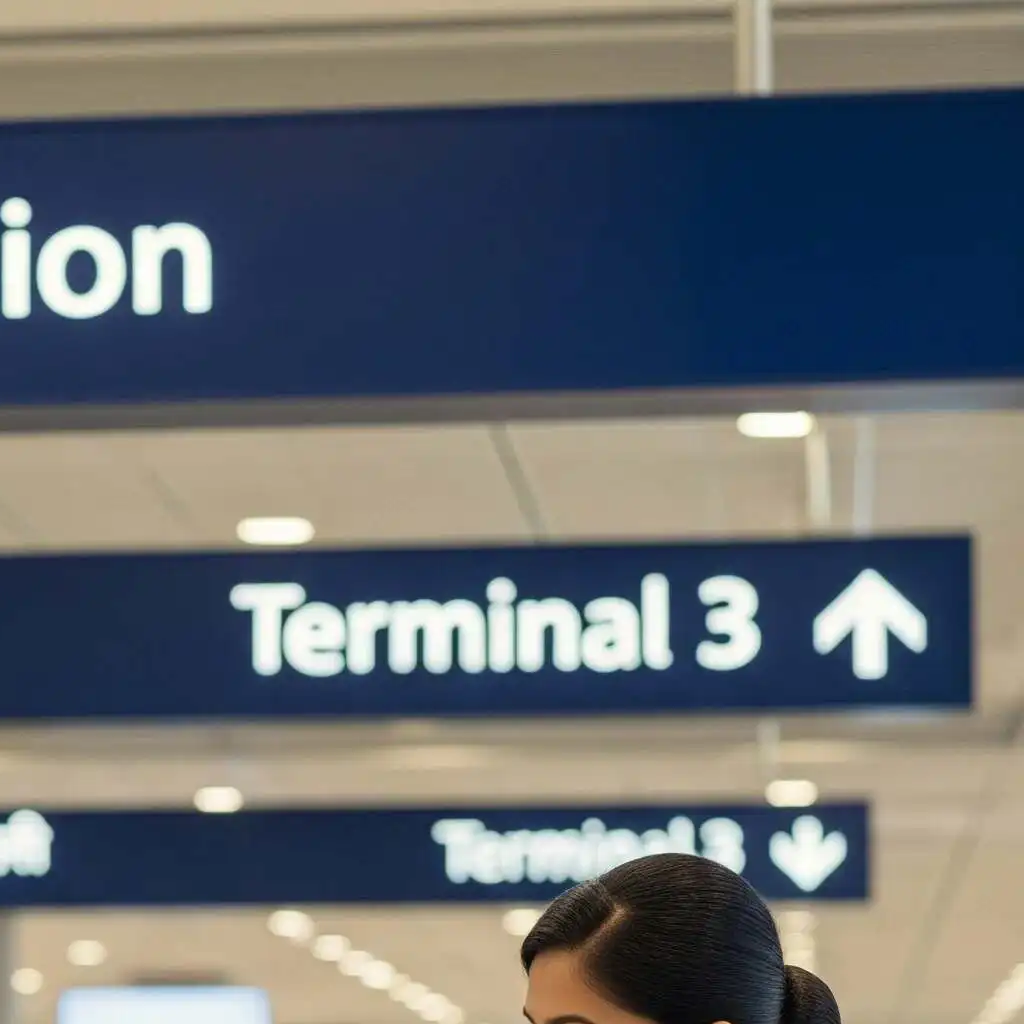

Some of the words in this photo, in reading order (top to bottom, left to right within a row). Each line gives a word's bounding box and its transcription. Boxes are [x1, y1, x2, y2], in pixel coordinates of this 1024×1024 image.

[230, 573, 673, 677] Terminal
[695, 574, 762, 671] 3
[699, 818, 745, 874] 3
